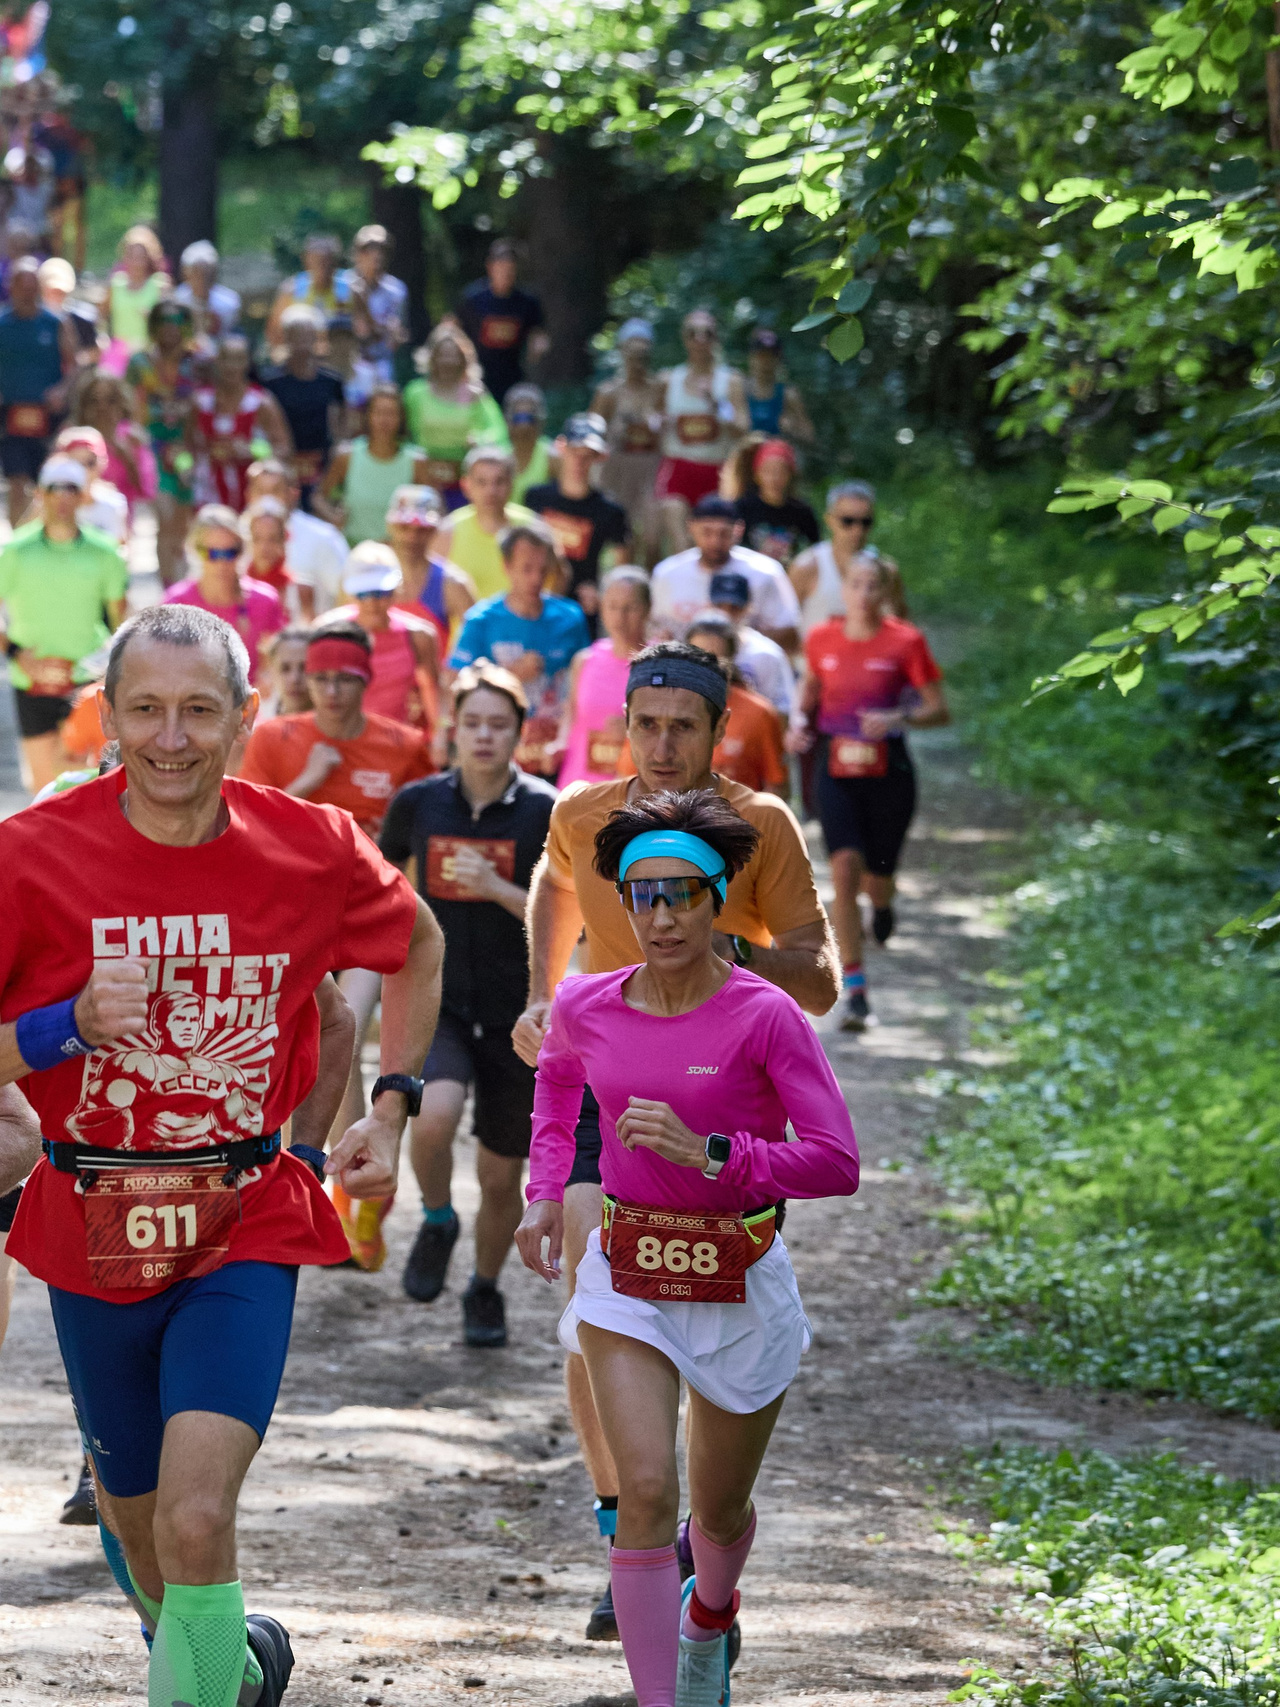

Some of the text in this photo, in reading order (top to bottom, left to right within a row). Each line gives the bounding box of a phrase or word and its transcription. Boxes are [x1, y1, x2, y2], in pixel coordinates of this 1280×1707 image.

[92, 913, 231, 957] СИЛА
[93, 953, 290, 995] СТЕТ
[159, 1073, 222, 1094] СССР
[126, 1203, 197, 1249] 611
[648, 1213, 675, 1223] РЕТРО
[676, 1217, 706, 1227] КРОСС
[636, 1235, 719, 1275] 868
[142, 1264, 154, 1278] 6
[659, 1284, 670, 1295] 6
